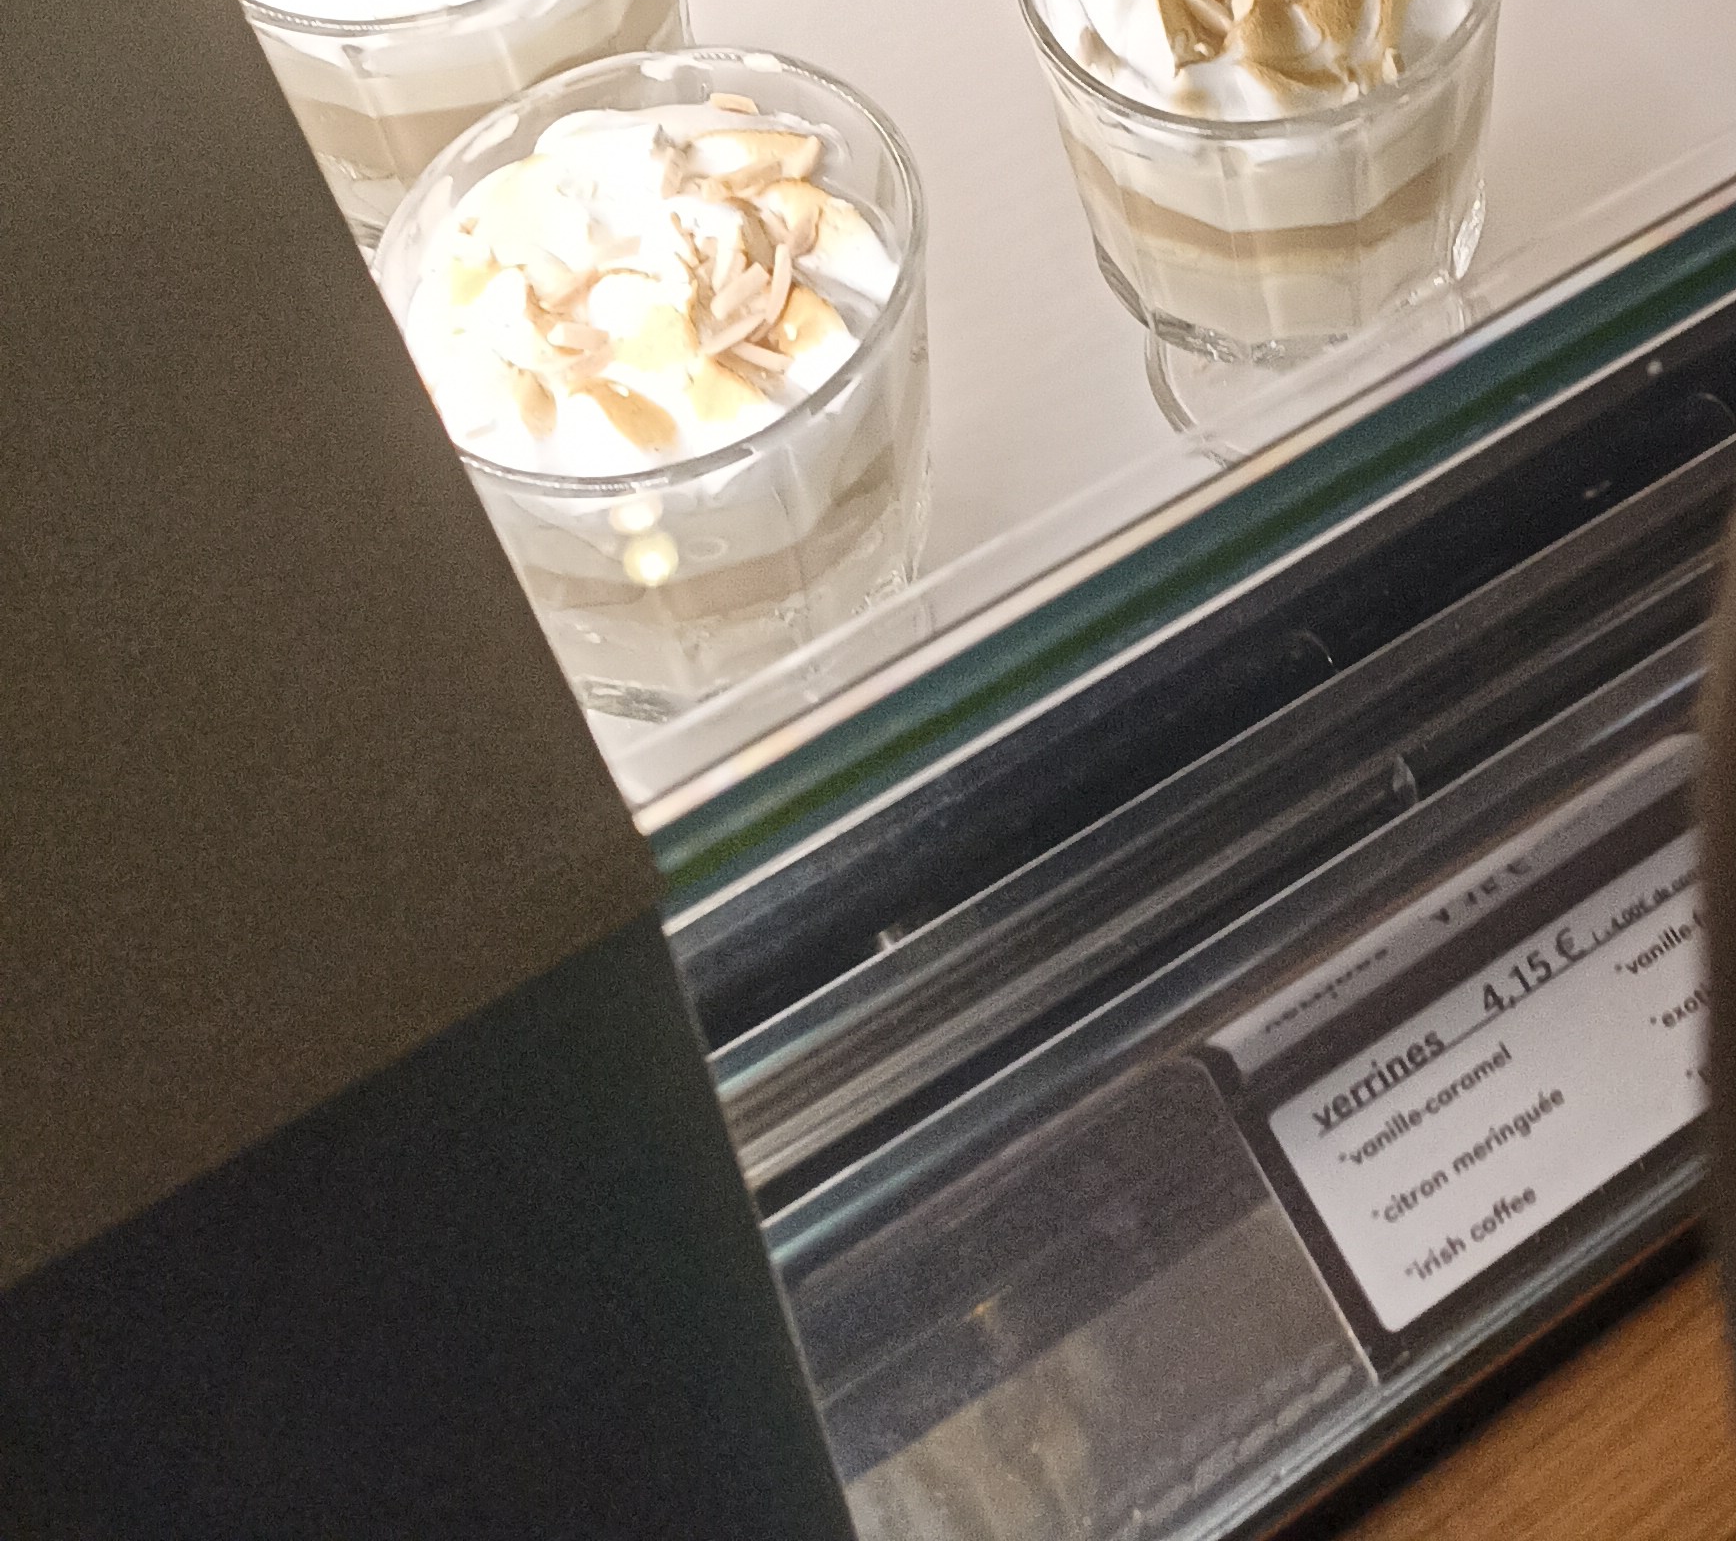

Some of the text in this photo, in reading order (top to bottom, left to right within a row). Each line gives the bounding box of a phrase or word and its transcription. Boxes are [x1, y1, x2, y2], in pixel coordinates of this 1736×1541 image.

[1312, 1029, 1445, 1134] verrines
[1483, 949, 1552, 1012] 4,15
[1555, 925, 1586, 962] €
[1452, 1088, 1565, 1176] meringuée
[1469, 1185, 1537, 1243] coffee
